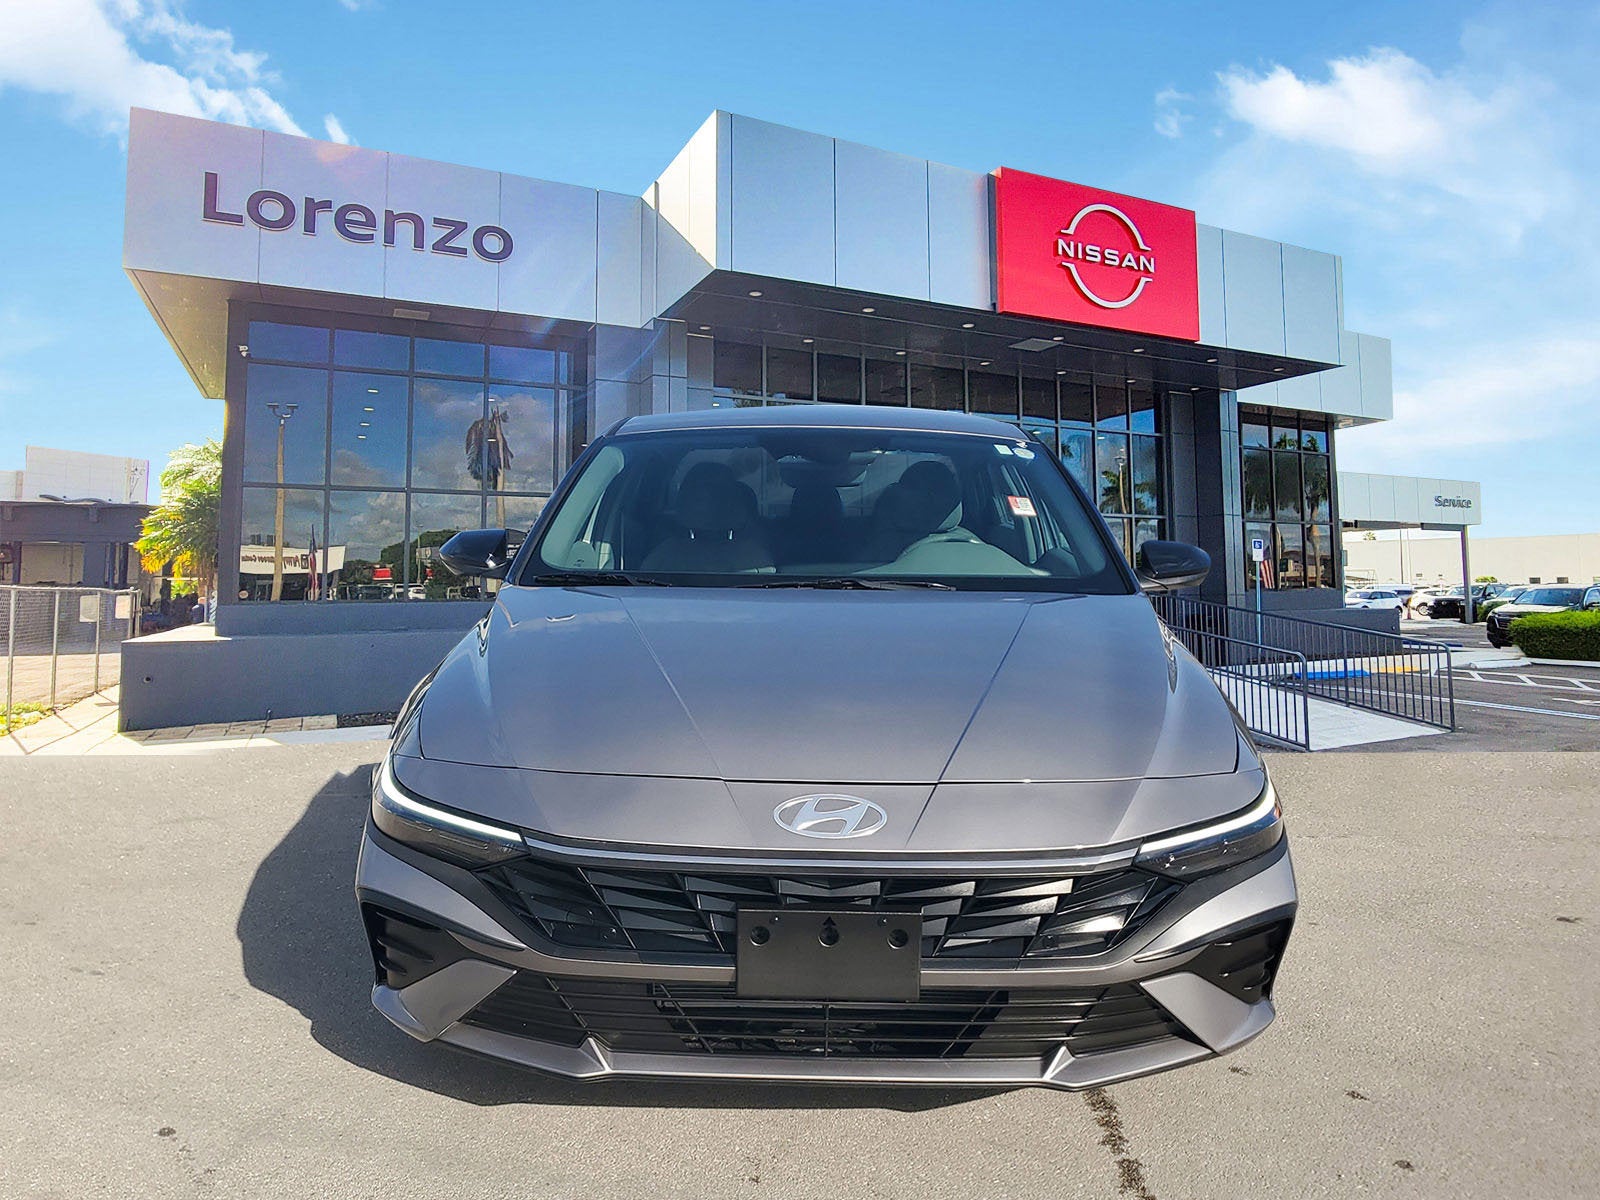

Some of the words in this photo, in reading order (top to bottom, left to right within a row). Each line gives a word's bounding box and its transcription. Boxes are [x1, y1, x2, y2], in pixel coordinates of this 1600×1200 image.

[203, 171, 514, 262] Lorenzo
[1057, 238, 1155, 273] NISSAN
[1434, 495, 1472, 508] Service
